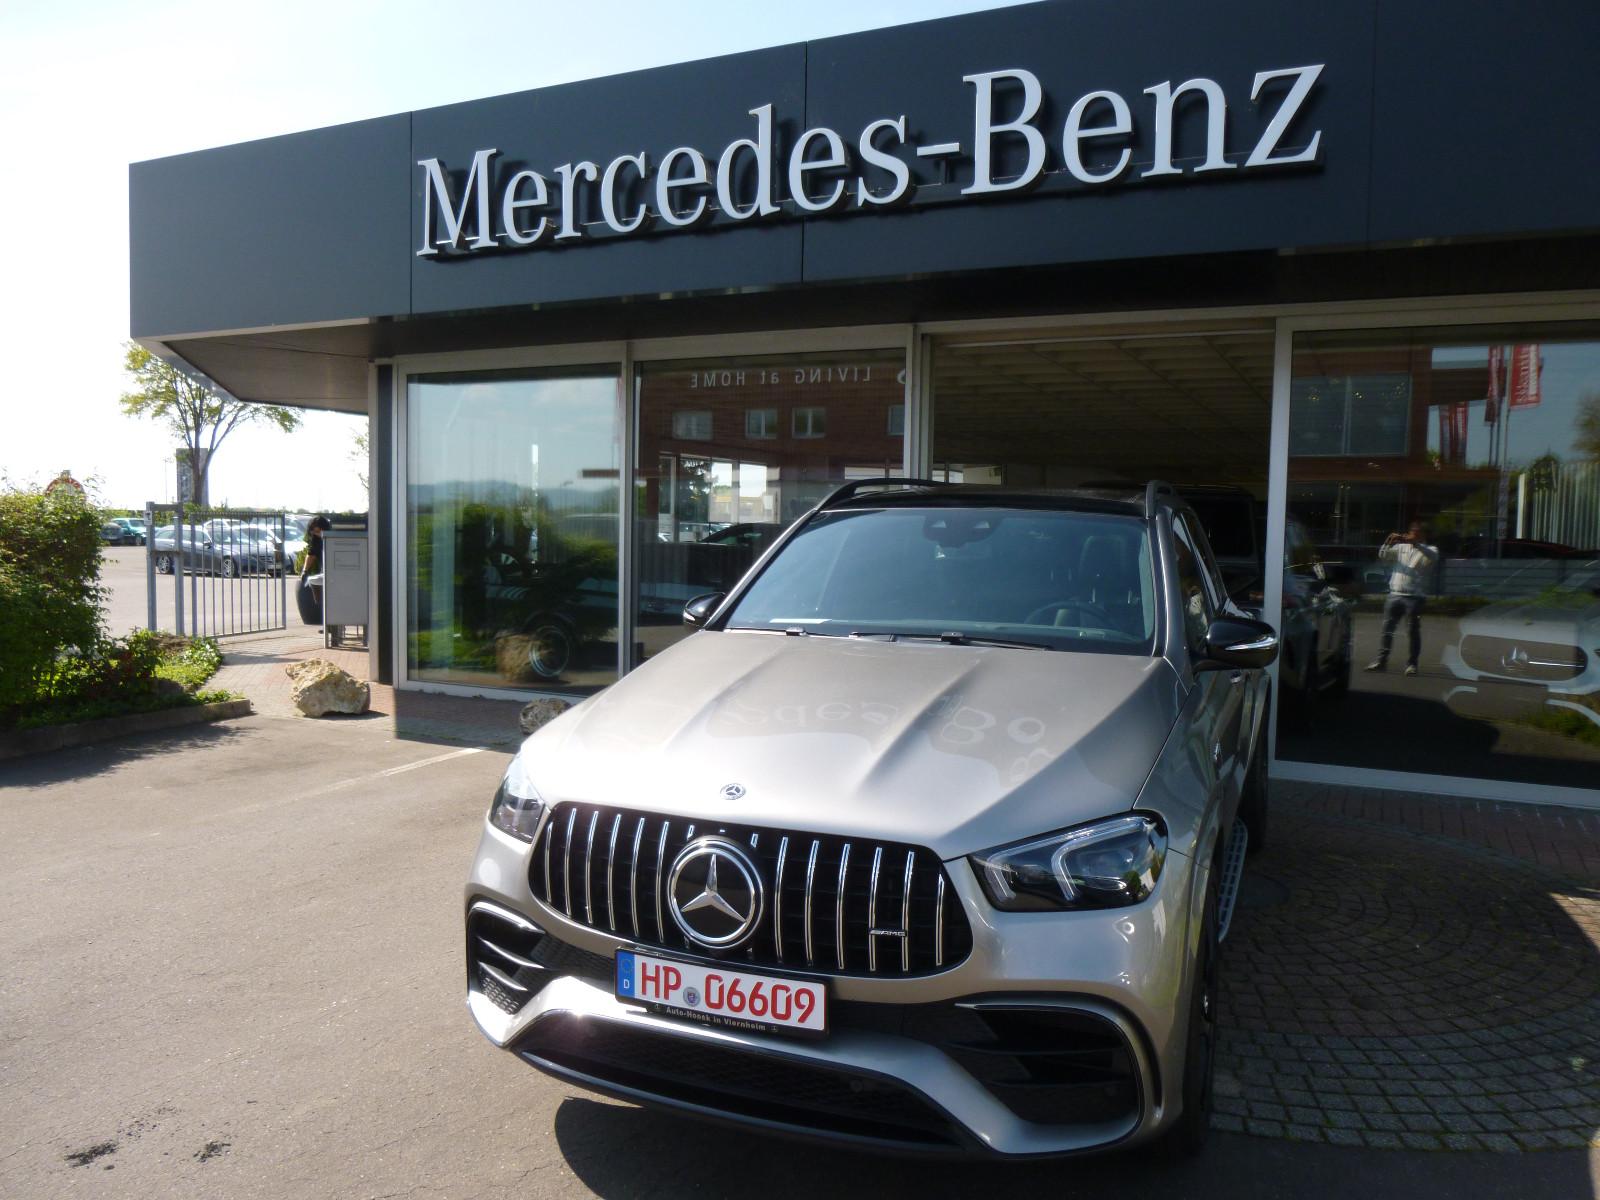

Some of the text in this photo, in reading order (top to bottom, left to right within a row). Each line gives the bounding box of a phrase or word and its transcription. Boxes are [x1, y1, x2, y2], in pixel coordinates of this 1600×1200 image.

[415, 63, 1326, 259] Mercedes-Benz
[623, 978, 631, 989] D
[641, 961, 816, 1024] HP 06609
